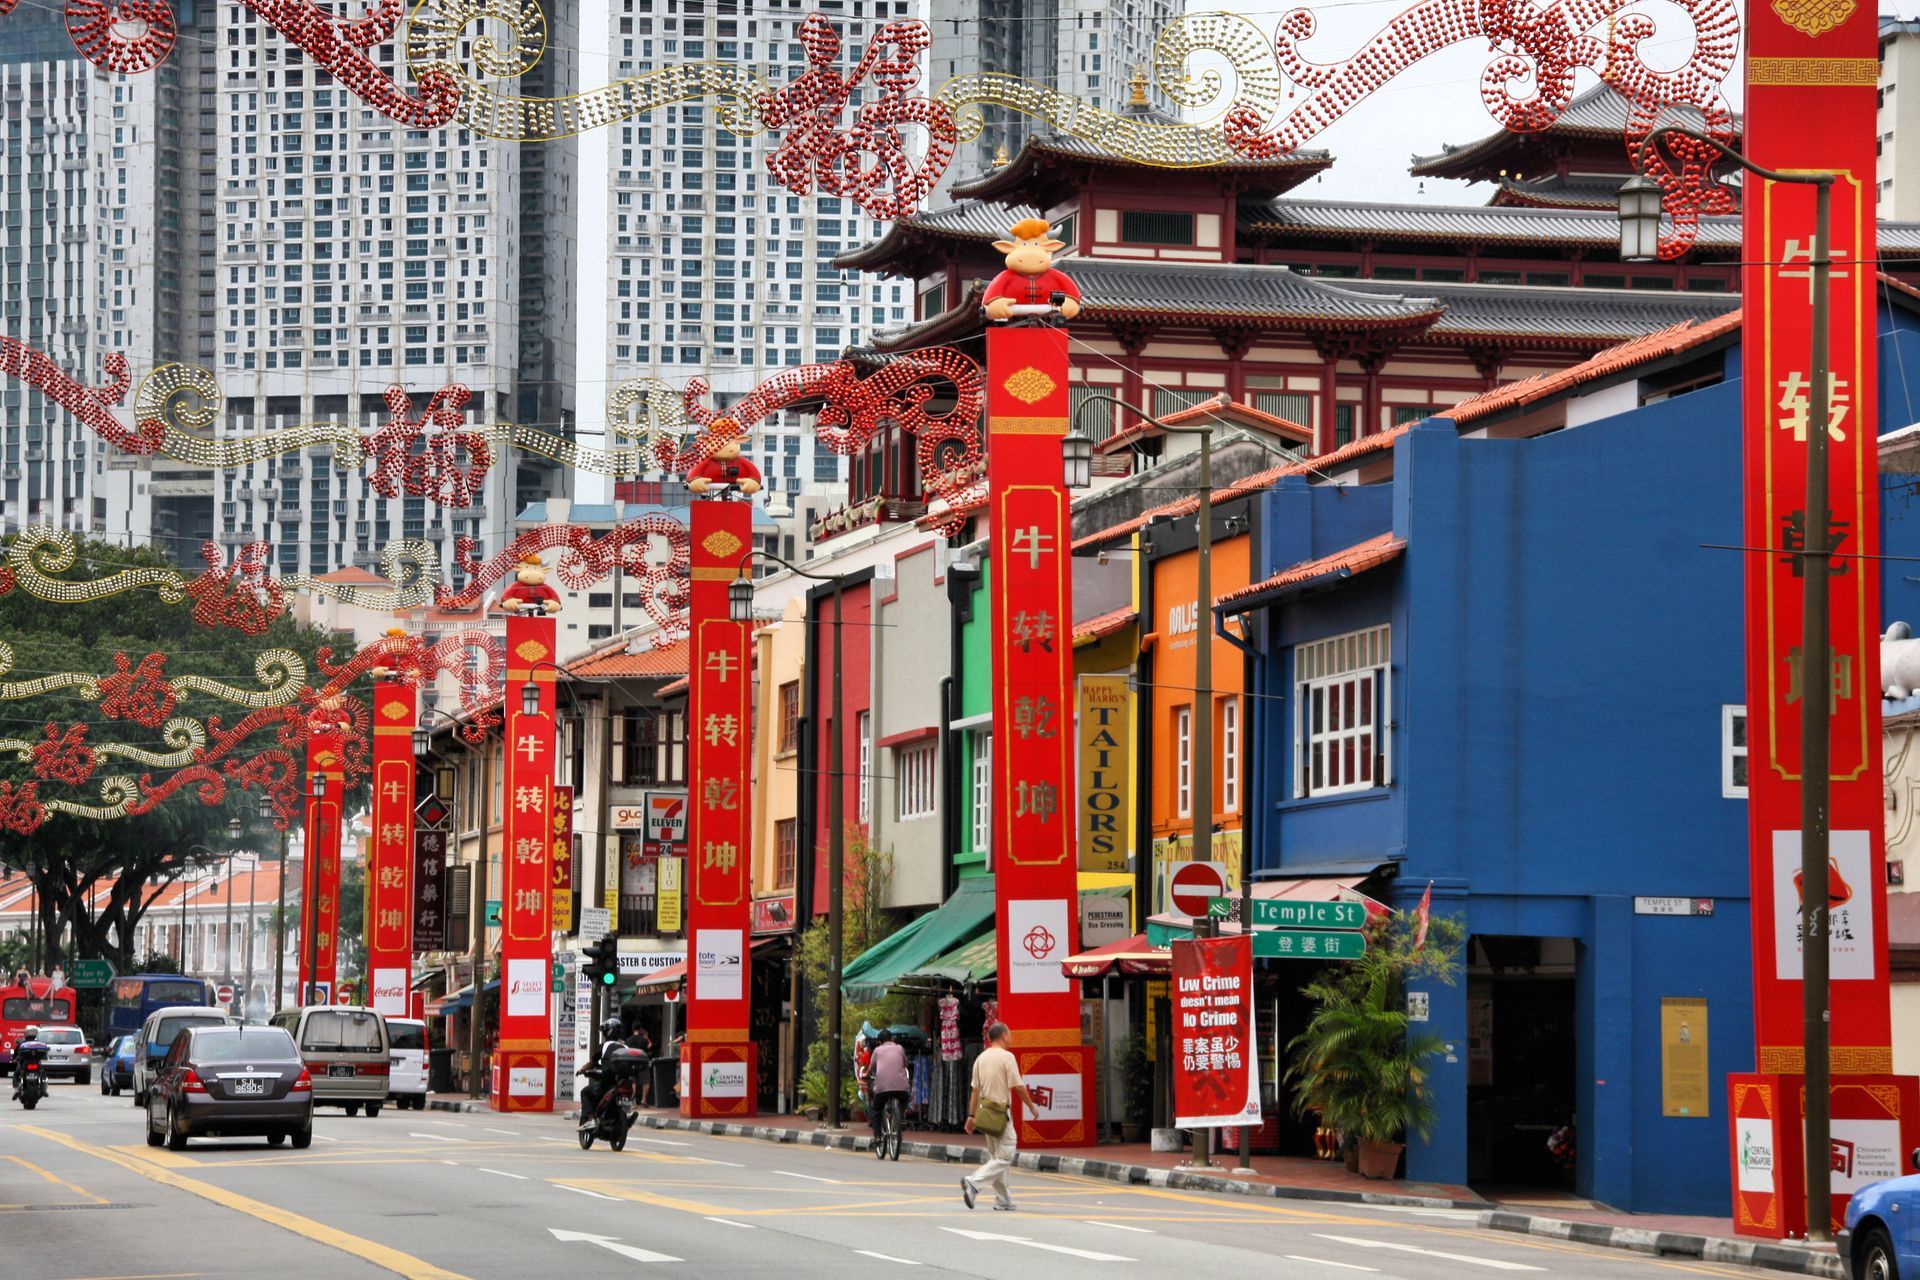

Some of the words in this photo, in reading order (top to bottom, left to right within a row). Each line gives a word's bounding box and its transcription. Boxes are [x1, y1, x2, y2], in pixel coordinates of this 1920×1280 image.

[1011, 525, 1055, 825] 牛转乾坤
[1083, 686, 1113, 694] HAPPY
[1089, 694, 1127, 702] HARRY'S
[704, 649, 739, 875] 牛转乾坤
[1087, 707, 1120, 854] TAILORS
[515, 735, 544, 916] 牛转乾坤
[378, 780, 406, 932] 牛转乾坤
[661, 844, 672, 855] 24
[609, 847, 617, 887] MUSIC
[1107, 861, 1125, 870] 254
[553, 893, 569, 904] ijing
[1643, 898, 1671, 906] TEMPLE
[1088, 911, 1124, 919] PEDESTRIANS
[1258, 902, 1326, 923] Temple
[1335, 905, 1355, 922] St
[1100, 921, 1124, 929] Crossing
[1278, 936, 1340, 954] 登婆街
[1179, 977, 1200, 992] Low
[1202, 976, 1240, 991] Crime
[1180, 995, 1212, 1008] doesn't
[1214, 995, 1240, 1007] mean
[1183, 1012, 1197, 1028] No
[1200, 1011, 1238, 1027] Crime
[1183, 1036, 1240, 1054] 罪案虽少
[1183, 1053, 1242, 1071] 仍要警惕
[1751, 1146, 1771, 1156] CENTRAL
[1749, 1156, 1771, 1166] SINGAPORE
